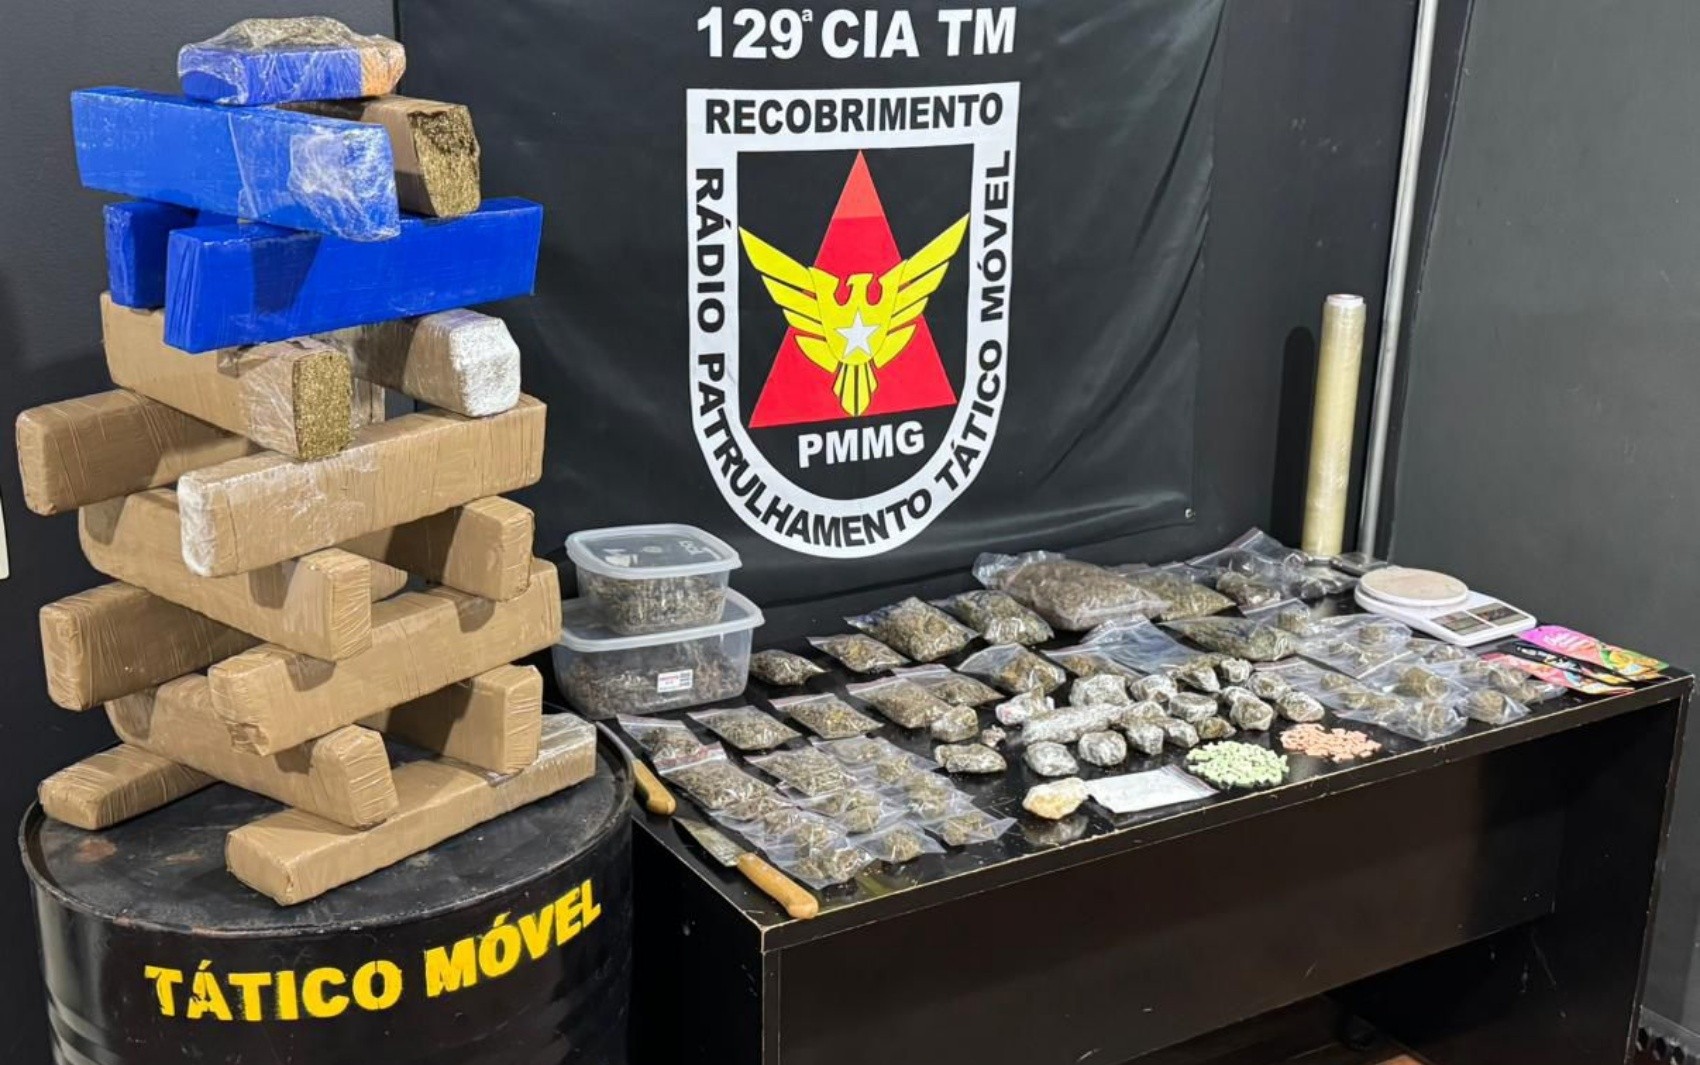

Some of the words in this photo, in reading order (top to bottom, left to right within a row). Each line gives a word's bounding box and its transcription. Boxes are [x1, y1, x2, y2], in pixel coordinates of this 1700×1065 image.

[821, 9, 920, 59] CIA
[938, 7, 1017, 57] TM
[705, 92, 1003, 135] RECOBRIMENTO
[696, 168, 731, 333] RÁDIO
[977, 150, 1011, 322] MÓVEL
[698, 353, 932, 548] PATRULHAMENTO
[798, 420, 925, 469] PMMG
[934, 339, 1003, 492] TÁTICO
[144, 960, 402, 1022] TÁTICO
[425, 879, 601, 997] MÓVEL
